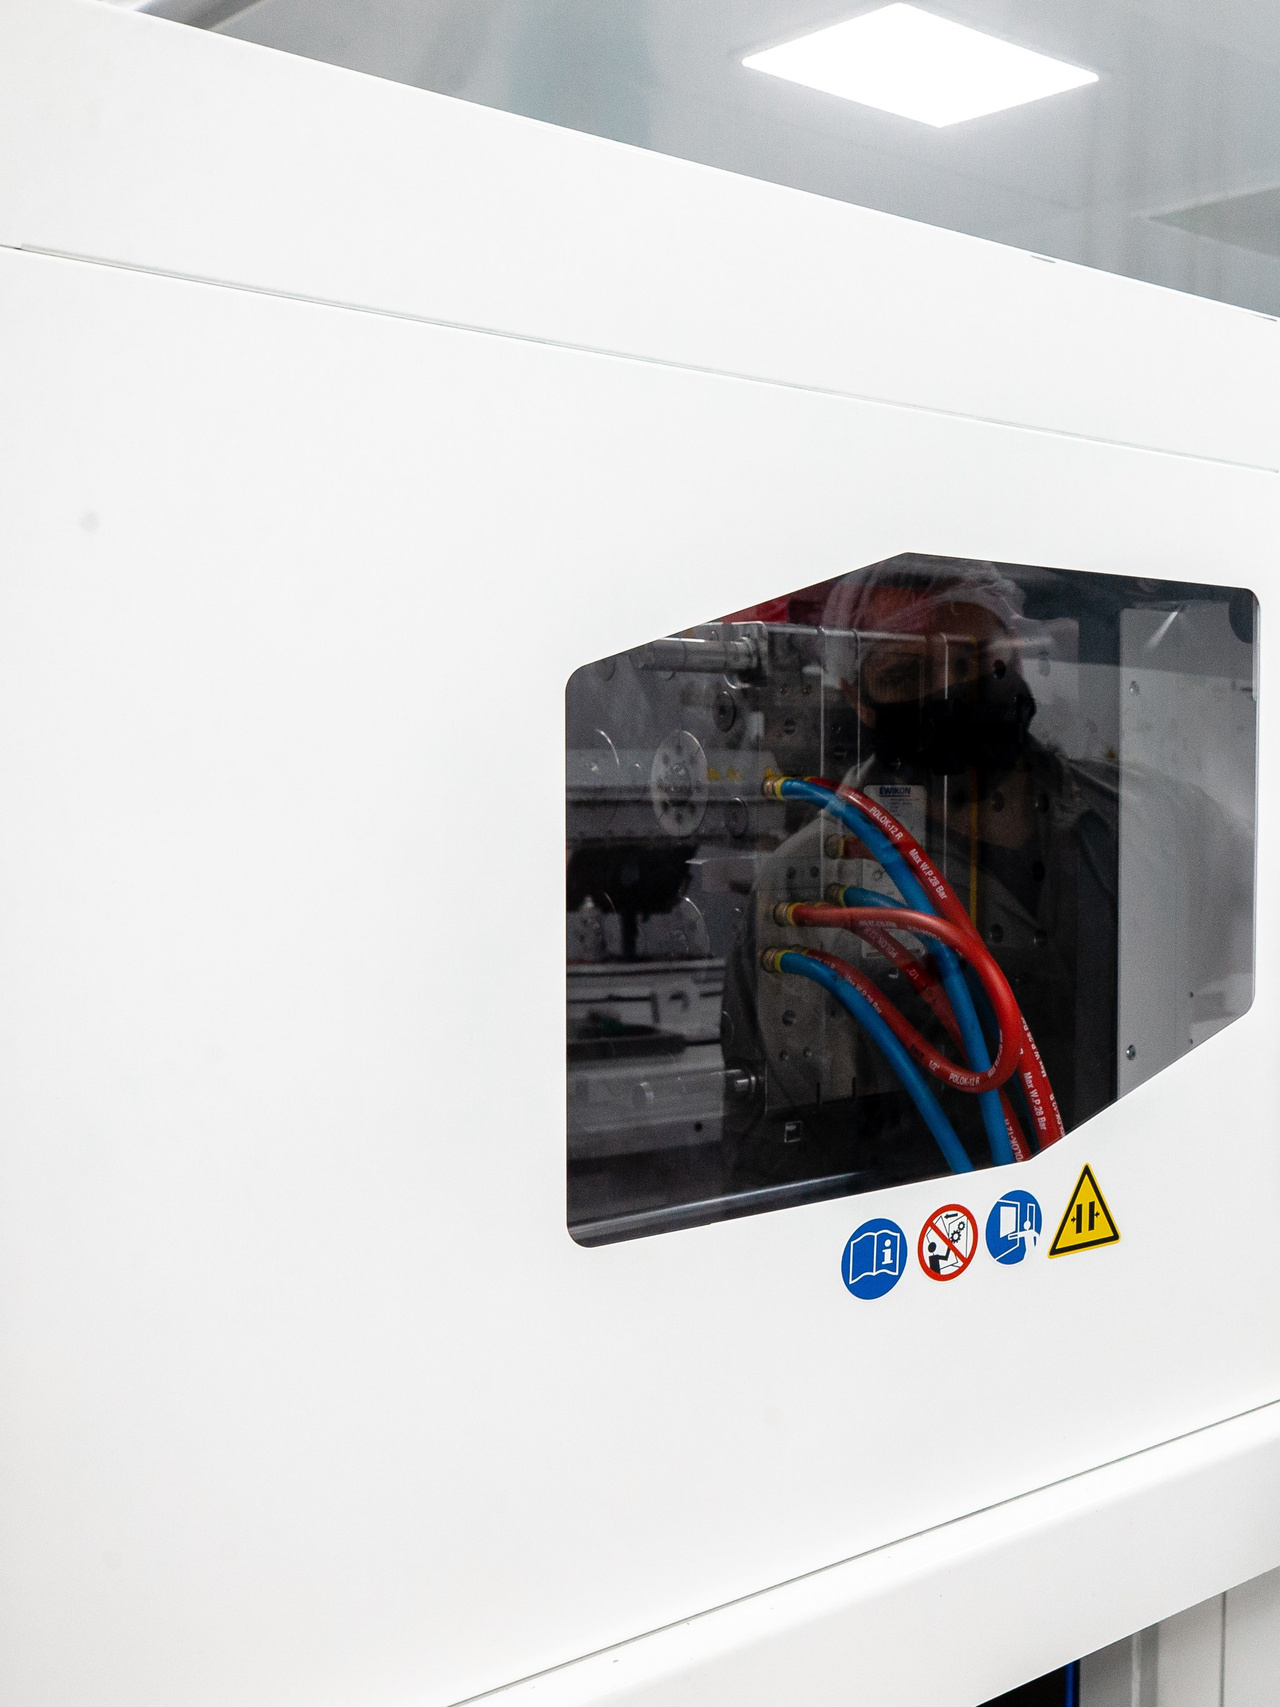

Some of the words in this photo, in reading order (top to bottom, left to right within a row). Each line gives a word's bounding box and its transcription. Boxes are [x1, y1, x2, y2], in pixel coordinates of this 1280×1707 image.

[909, 849, 922, 864] Max
[936, 886, 947, 899] Bar
[1023, 1072, 1034, 1089] Max
[1038, 1116, 1047, 1131] Bar
